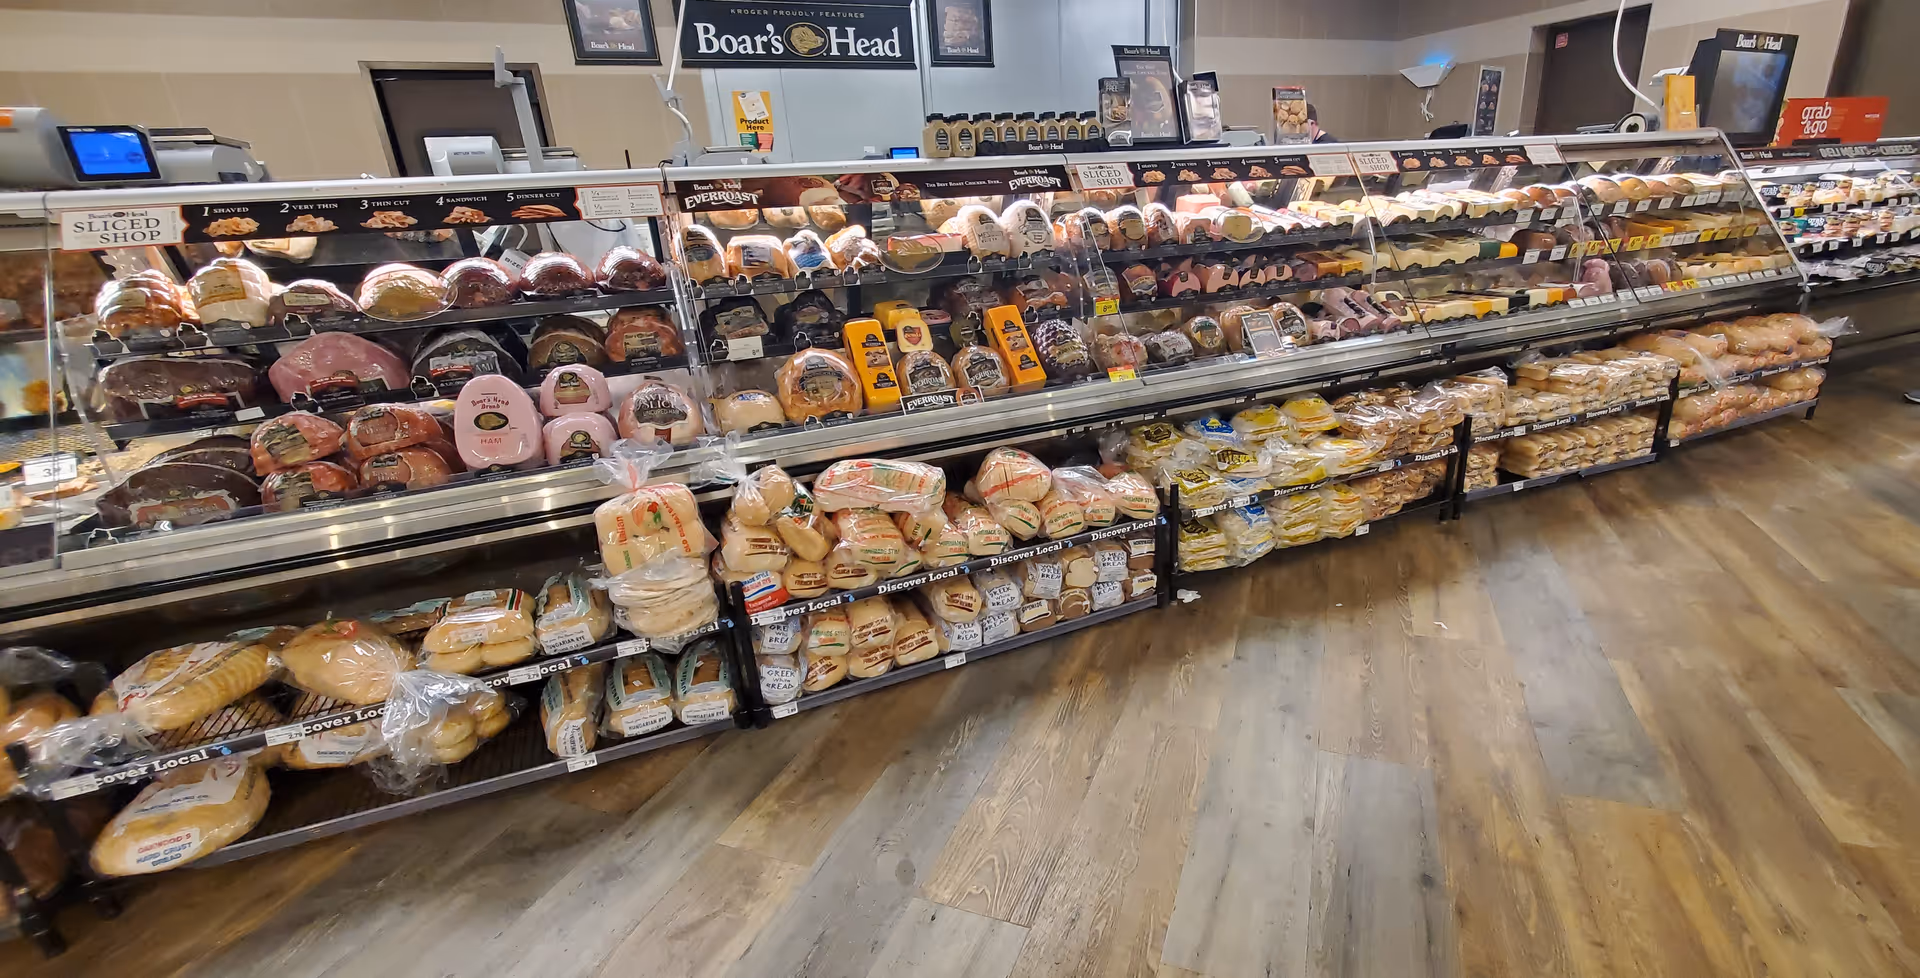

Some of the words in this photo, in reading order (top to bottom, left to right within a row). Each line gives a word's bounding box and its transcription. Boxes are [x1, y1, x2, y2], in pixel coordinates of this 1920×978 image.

[730, 8, 769, 16] KROGER
[819, 11, 865, 19] FEATURES
[693, 22, 784, 55] Boar's
[827, 26, 902, 58] Head
[1736, 33, 1757, 49] Boar's
[1763, 35, 1783, 51] Head
[1801, 101, 1832, 125] grab
[739, 118, 770, 126] Product
[745, 124, 765, 132] Here
[1050, 142, 1064, 150] Head
[1819, 147, 1841, 158] DELI
[1359, 156, 1388, 165] SLICED
[1369, 163, 1391, 171] SHOP
[1083, 169, 1122, 179] SLICED
[1096, 176, 1124, 186] SHOP
[1009, 174, 1062, 191] EVERROAST
[435, 195, 445, 206] 4
[446, 195, 488, 204] SANDWICH
[506, 191, 515, 202] 5
[516, 193, 543, 201] DINNER
[544, 191, 561, 199] CUT
[684, 190, 759, 210] EVERROAST
[202, 205, 210, 217] 1
[213, 206, 249, 214] SHAVED
[279, 202, 290, 214] 2
[291, 203, 314, 211] VERY
[316, 202, 338, 210] THIN
[359, 199, 369, 210] 3
[371, 200, 391, 208] THIN
[392, 199, 411, 207] CUT
[73, 217, 161, 234] SLICED
[99, 230, 161, 245] SHOP
[907, 394, 955, 411] EVERROAST
[1586, 408, 1608, 419] Discover
[1608, 405, 1622, 414] Local
[1532, 421, 1555, 431] Discover
[1555, 416, 1571, 426] Local
[480, 437, 503, 445] HAM
[1473, 432, 1500, 444] Discover
[1501, 429, 1514, 438] Loca
[1273, 484, 1309, 497] Discover
[615, 515, 628, 547] Italian
[1091, 524, 1131, 542] Discover
[1132, 519, 1157, 531] Local
[989, 548, 1036, 567] Discover
[1036, 541, 1063, 556] Local
[755, 570, 769, 581] STYLE
[877, 577, 927, 596] Discover
[928, 566, 959, 583] Local
[808, 596, 842, 612] Local
[540, 659, 573, 676] ocal
[766, 669, 796, 678] GREEK
[765, 682, 795, 690] BREAD
[304, 714, 352, 735] cover
[356, 707, 386, 722] Loc
[96, 765, 150, 787] cover
[152, 749, 210, 773] Local
[163, 842, 193, 857] CRUST
